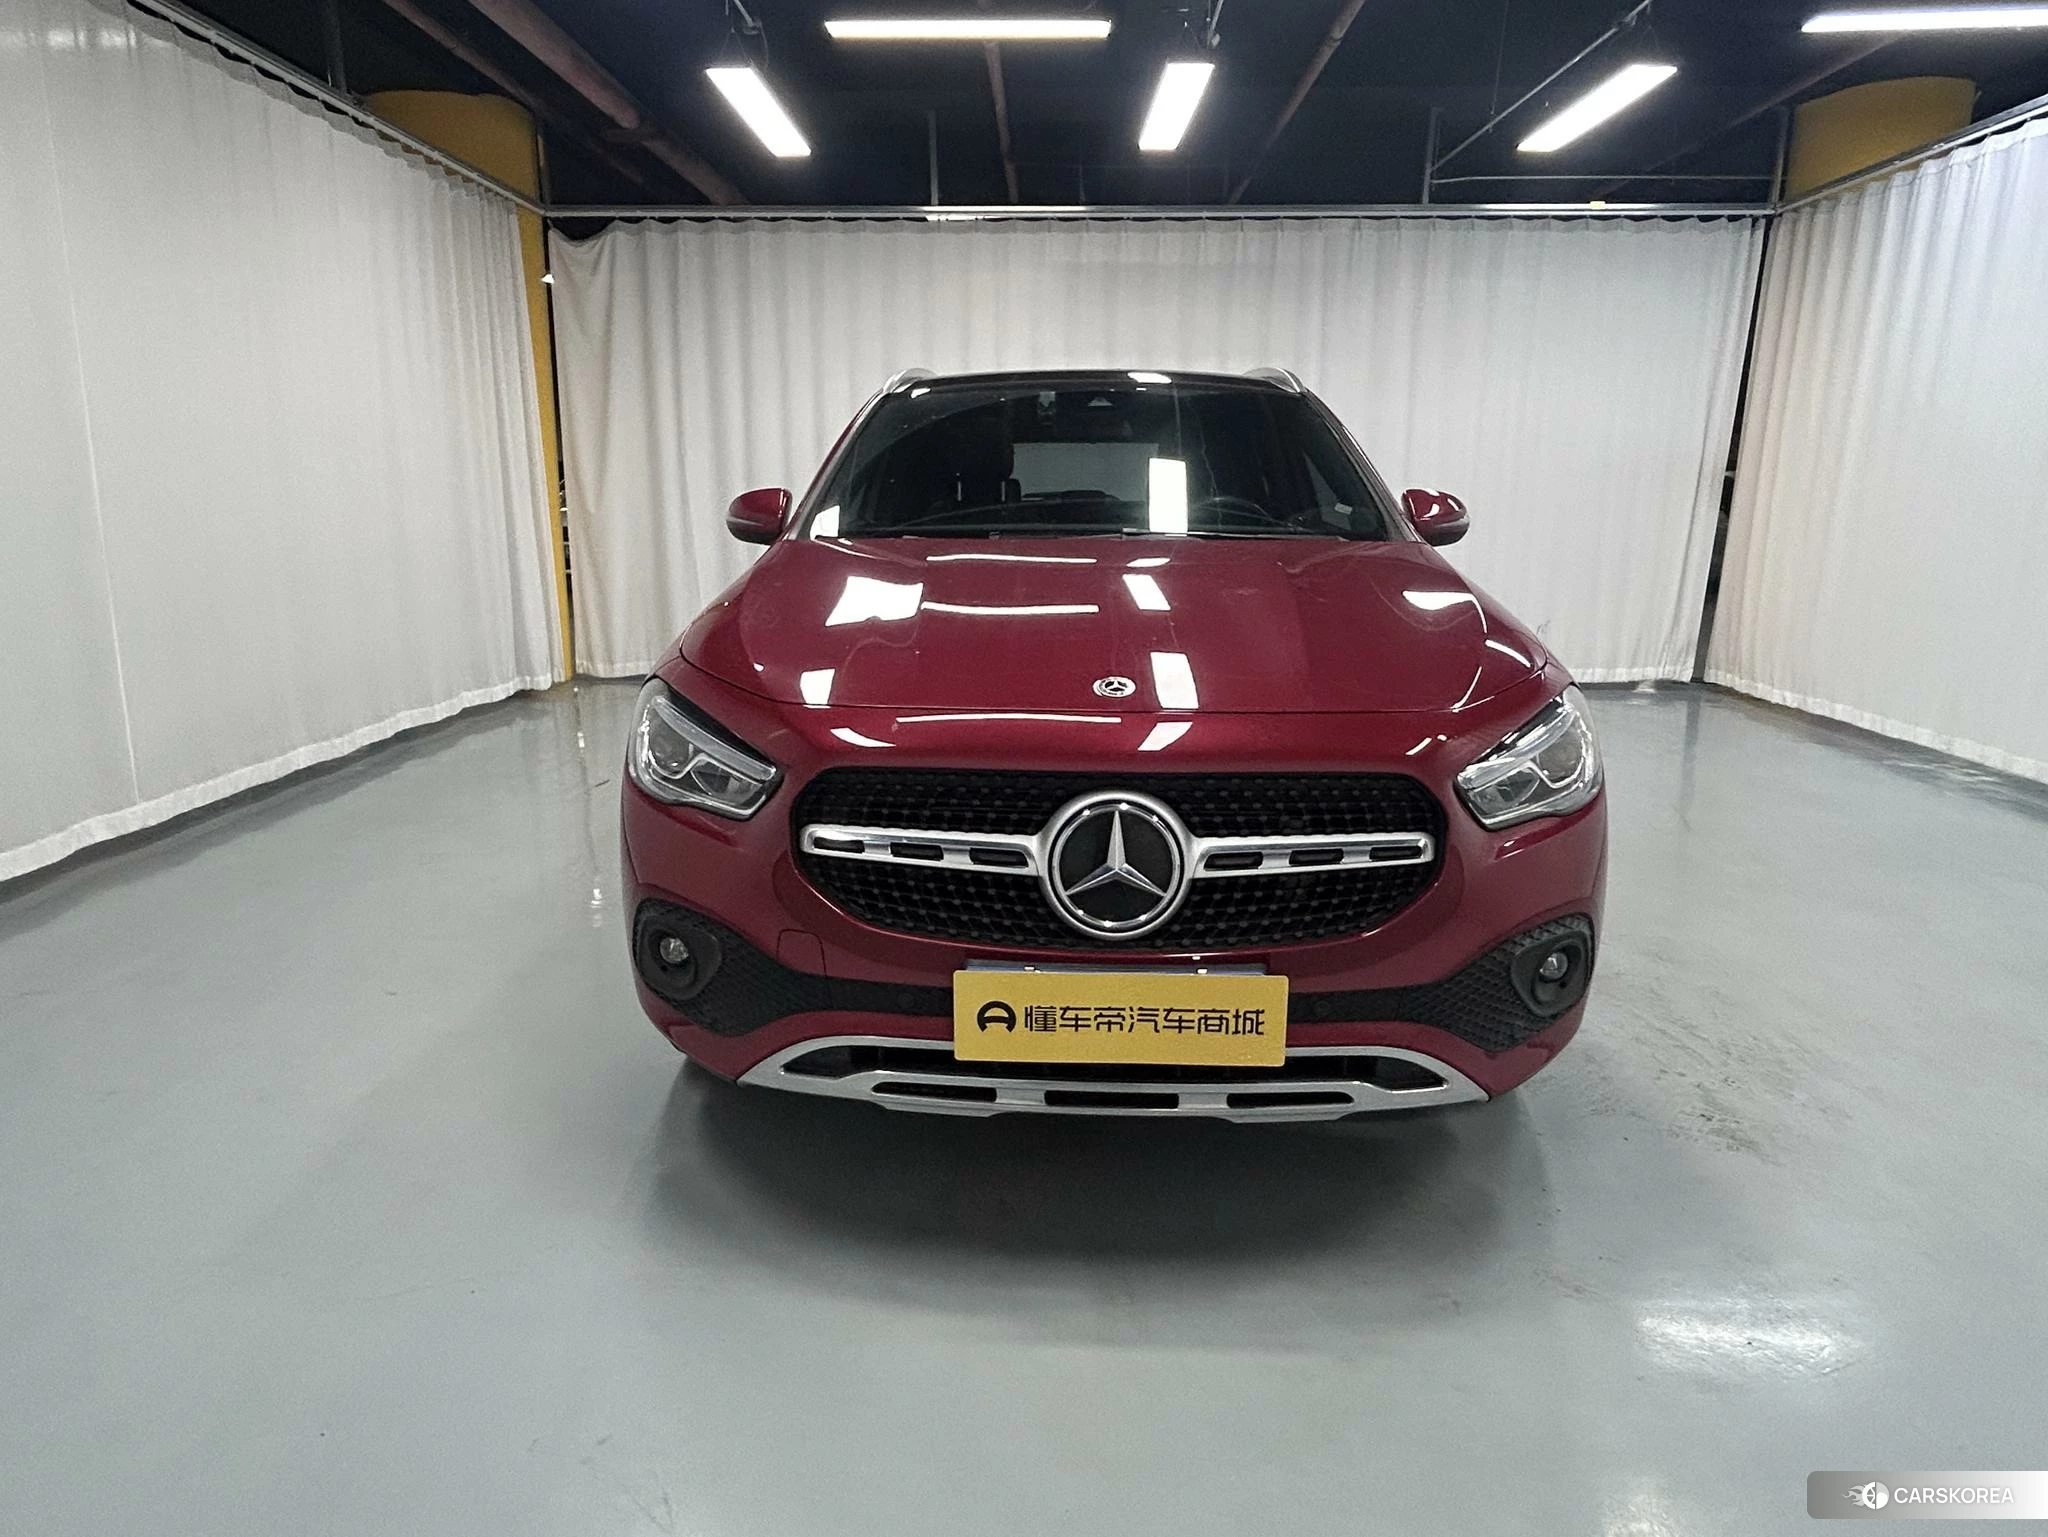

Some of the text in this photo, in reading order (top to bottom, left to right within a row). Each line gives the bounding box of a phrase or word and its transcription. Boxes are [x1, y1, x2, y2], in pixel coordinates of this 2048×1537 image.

[1024, 1005, 1265, 1035] 懂车帝汽车商城
